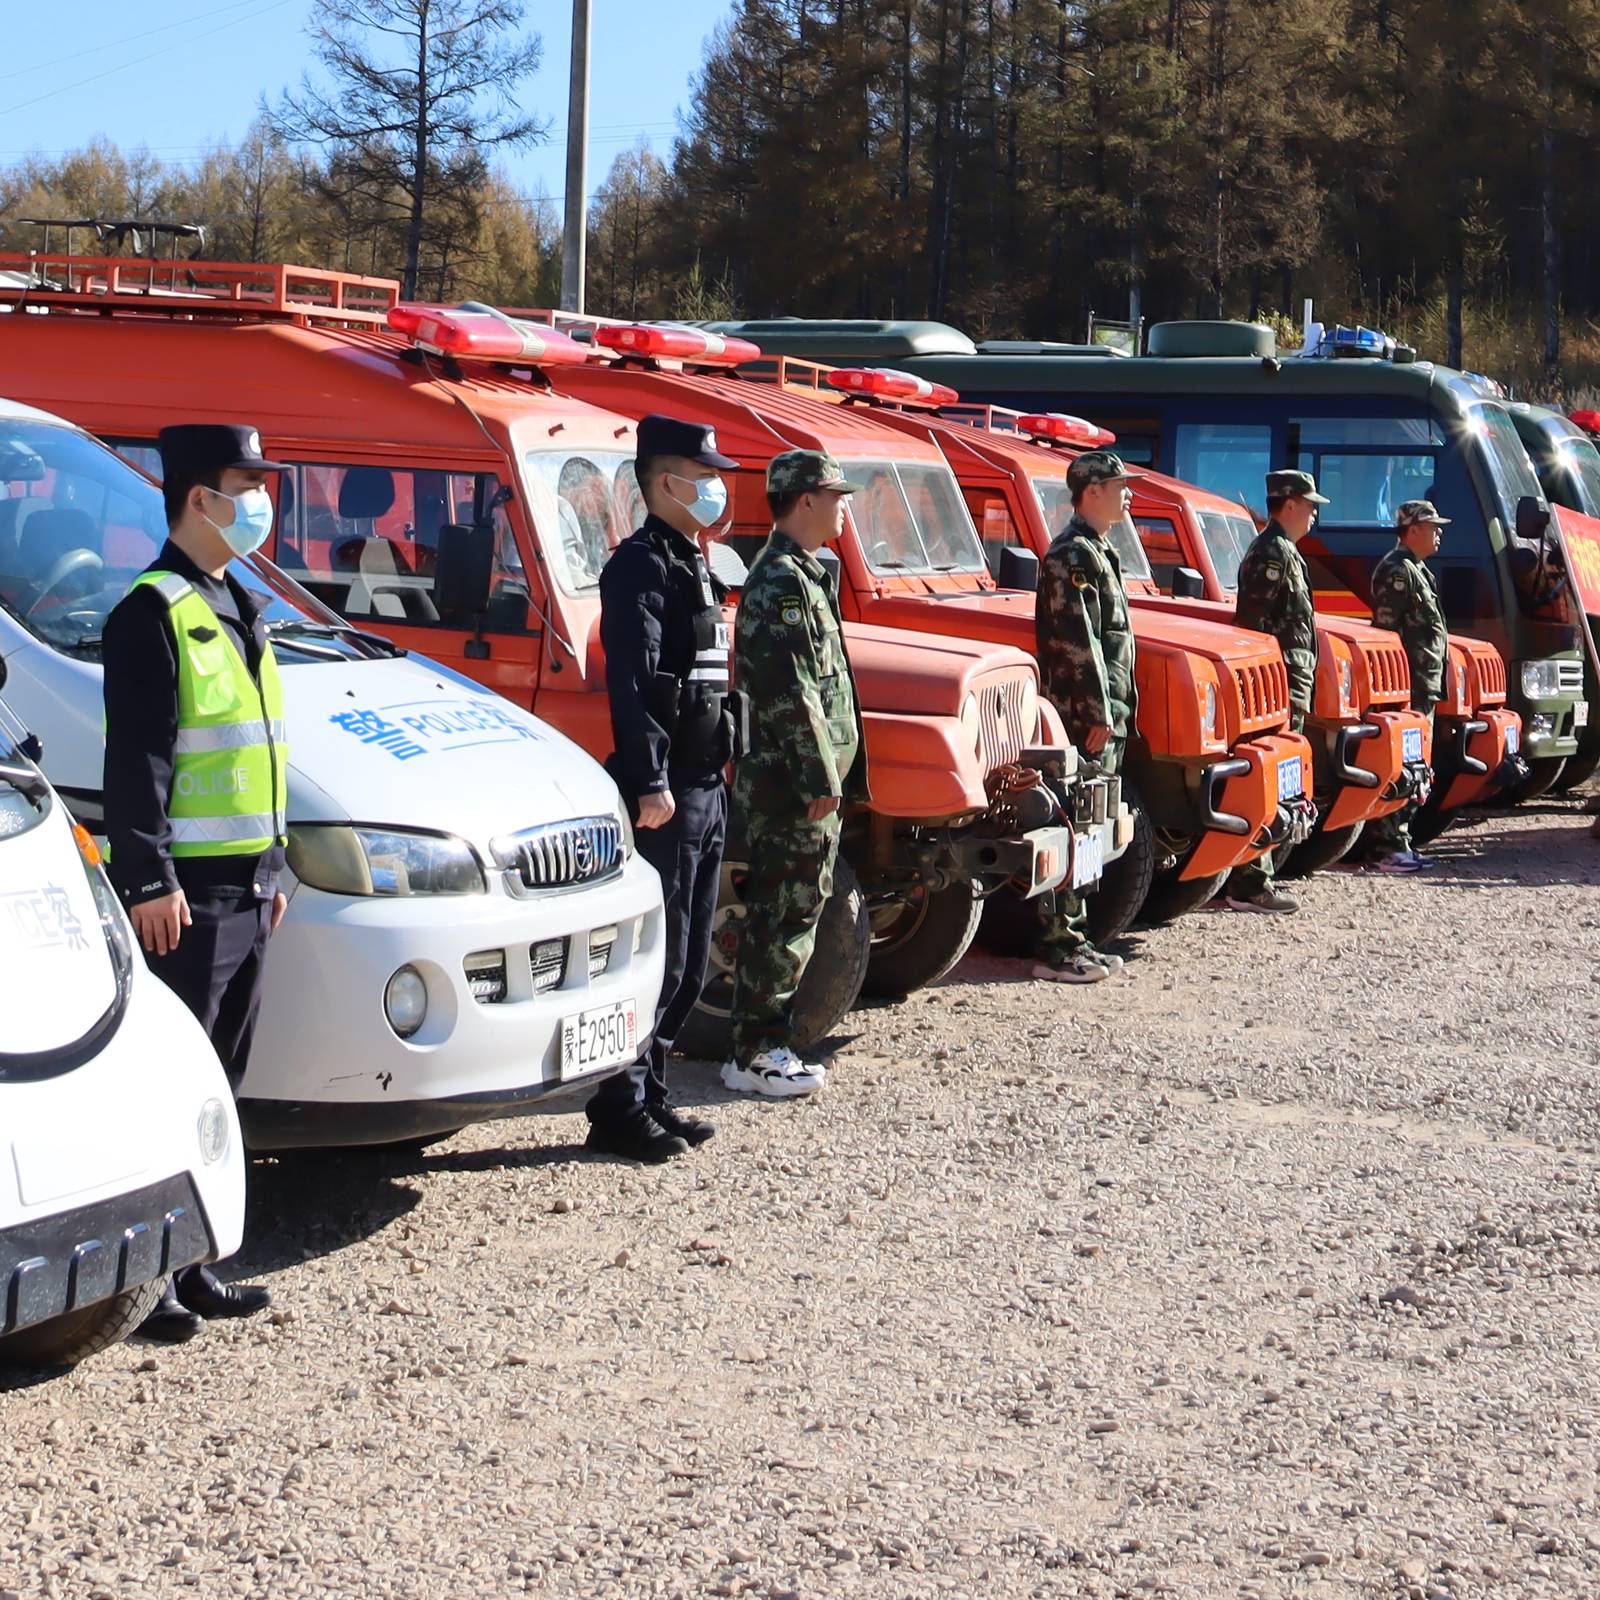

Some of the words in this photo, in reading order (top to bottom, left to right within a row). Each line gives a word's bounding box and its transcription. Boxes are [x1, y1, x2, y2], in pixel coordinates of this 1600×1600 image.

[328, 708, 429, 761] 警
[401, 710, 504, 738] POLICE
[177, 768, 249, 796] OLICE
